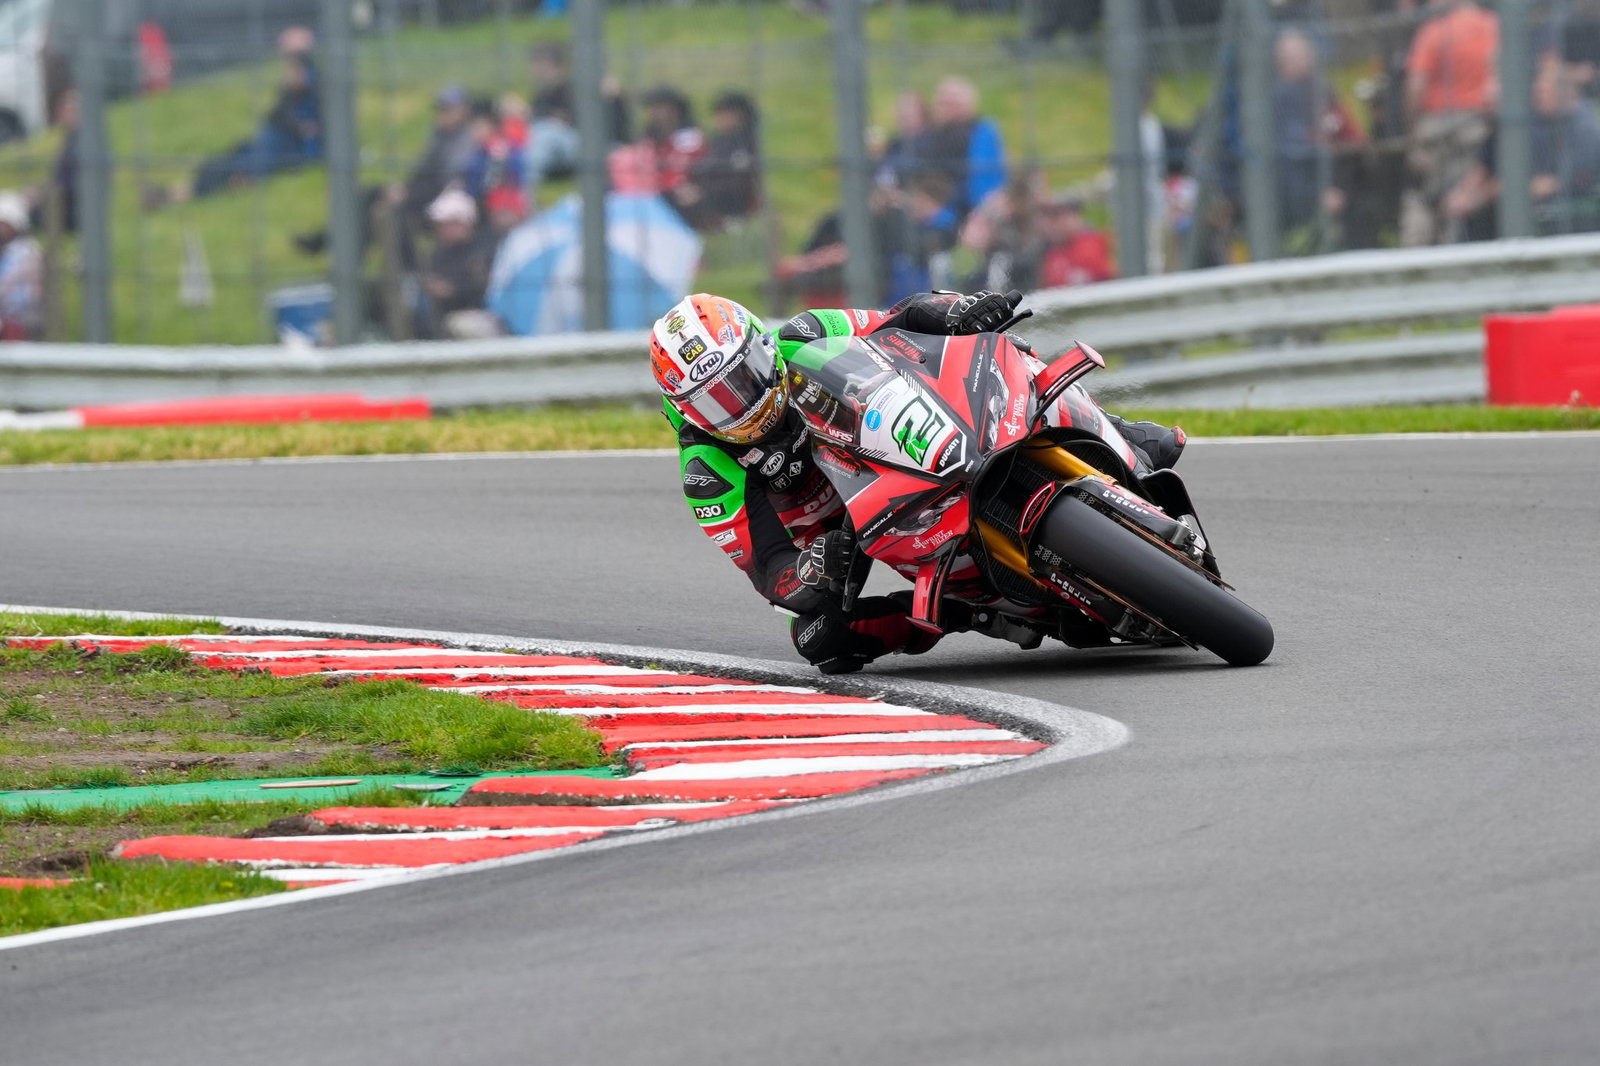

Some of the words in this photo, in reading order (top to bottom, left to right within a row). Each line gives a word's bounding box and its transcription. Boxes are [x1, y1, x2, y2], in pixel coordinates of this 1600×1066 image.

[685, 344, 704, 362] CAB
[693, 353, 721, 381] Arai
[828, 428, 854, 443] WRS
[891, 395, 946, 467] 2
[938, 438, 960, 468] DUCATI
[1102, 490, 1150, 514] PIRELLI
[1050, 572, 1092, 606] PIRELLI
[798, 614, 827, 648] RST
